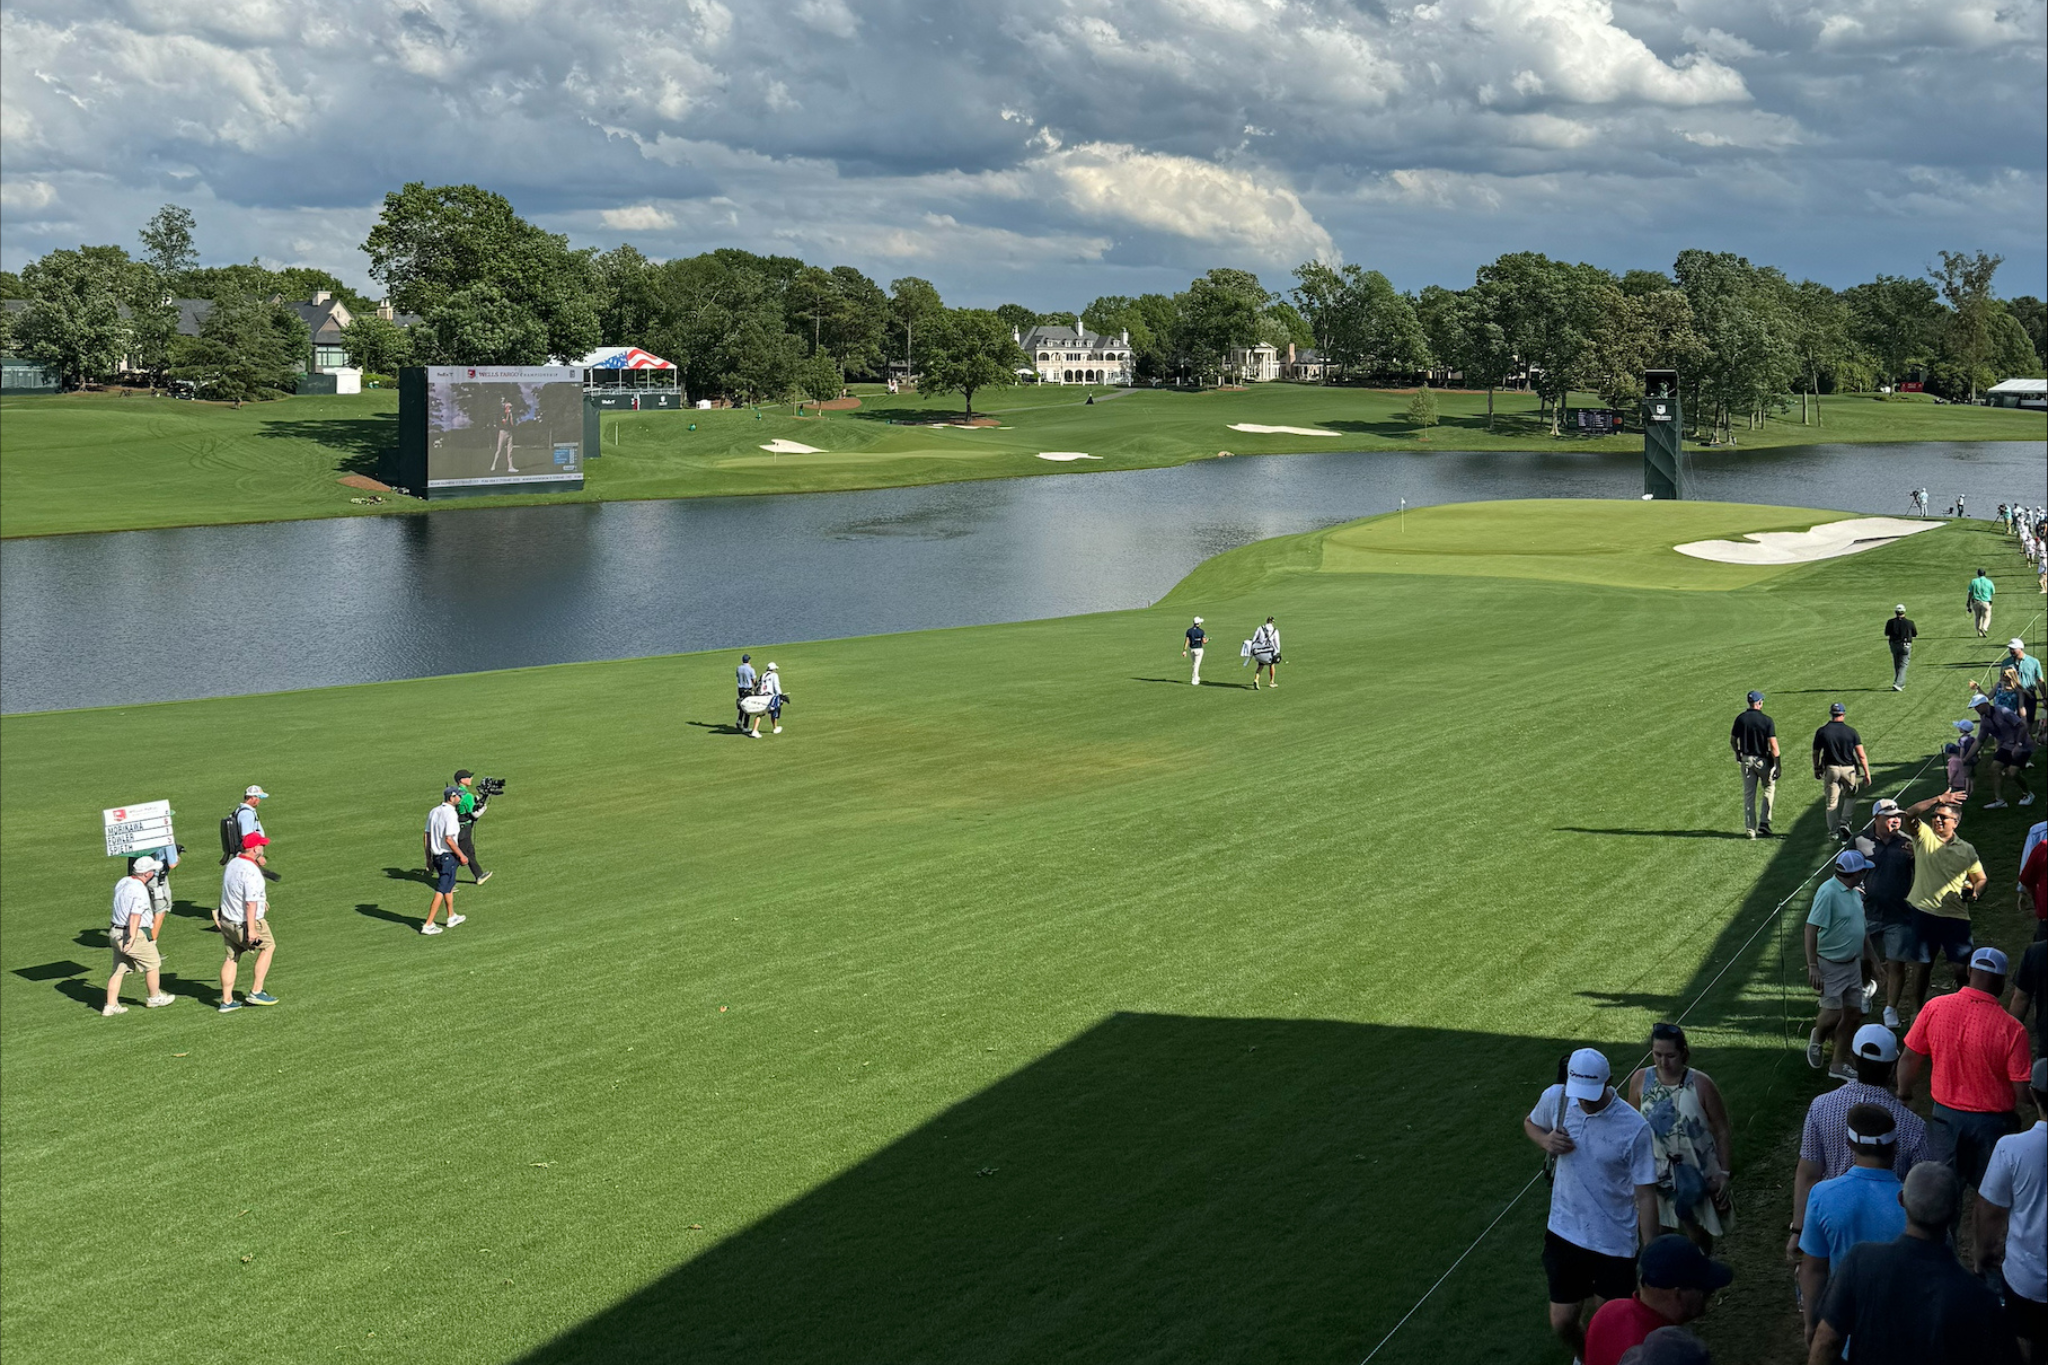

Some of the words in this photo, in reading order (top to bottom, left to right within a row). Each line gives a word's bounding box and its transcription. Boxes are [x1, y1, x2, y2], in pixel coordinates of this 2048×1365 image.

[107, 822, 143, 835] MORIKAWA
[107, 833, 134, 846] FOWLER
[109, 845, 134, 856] SPIETH
